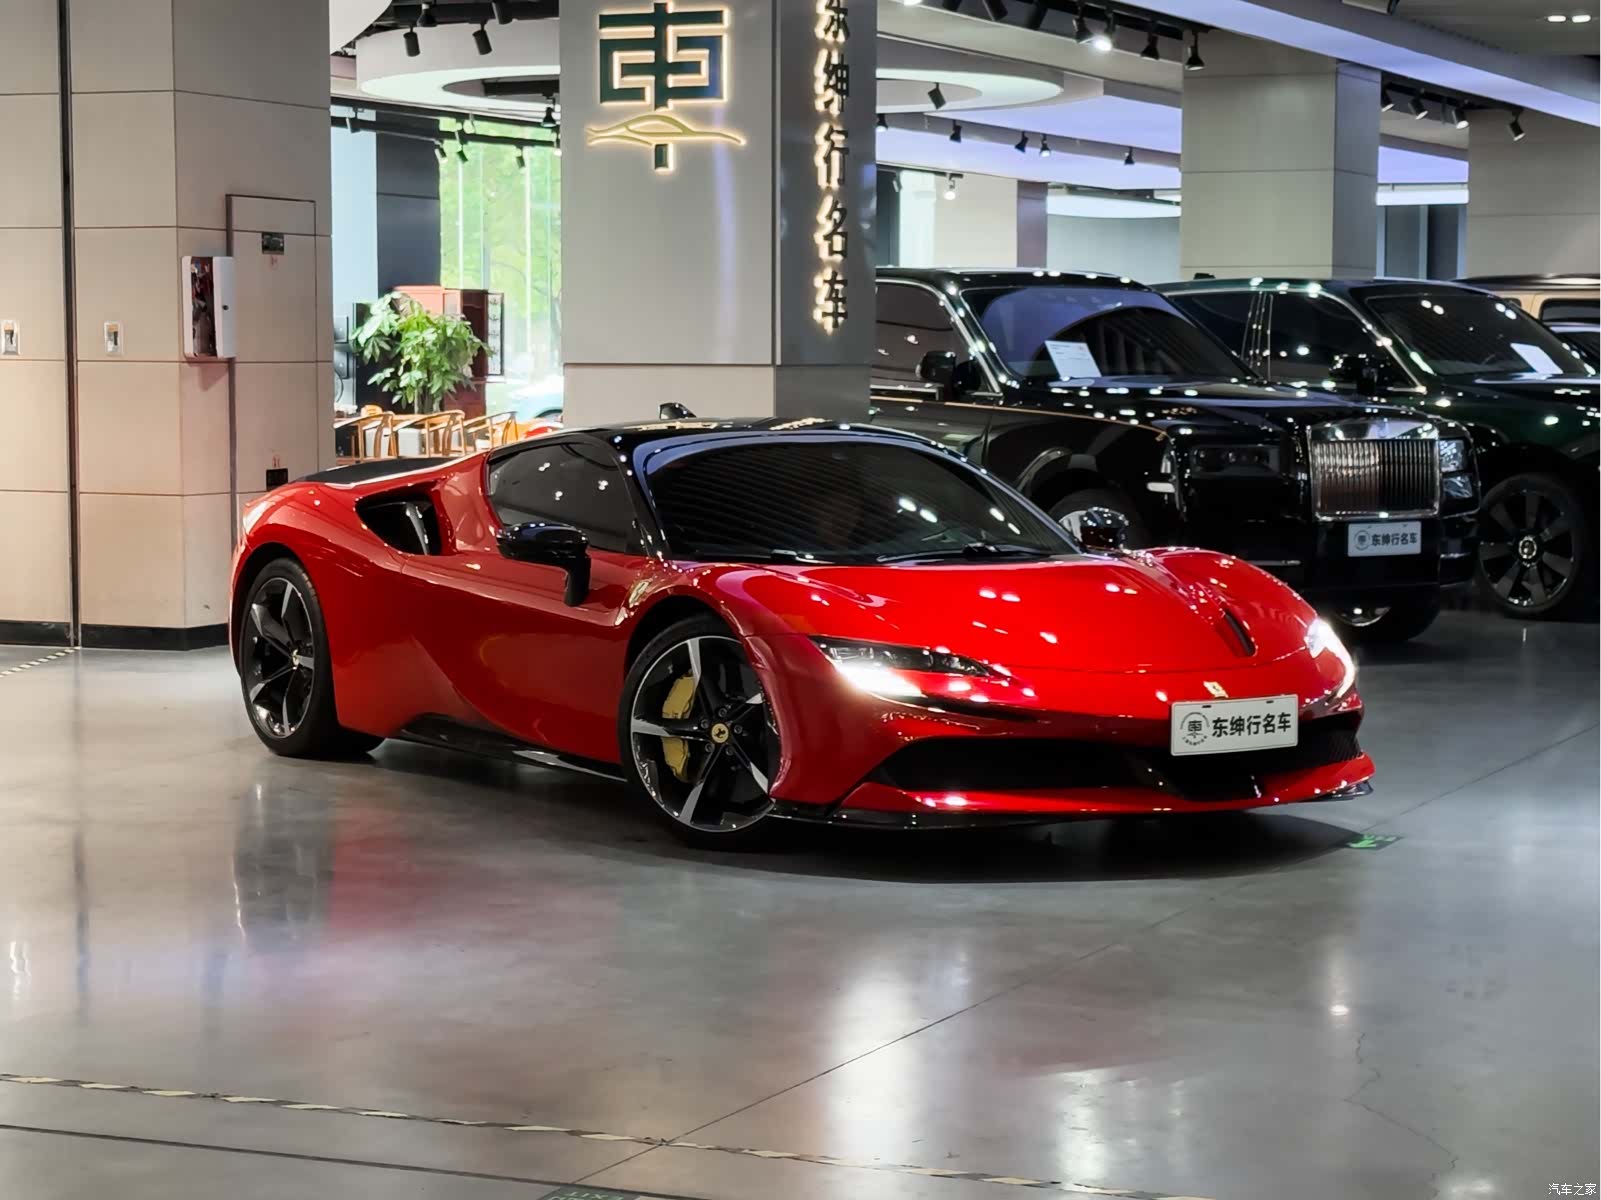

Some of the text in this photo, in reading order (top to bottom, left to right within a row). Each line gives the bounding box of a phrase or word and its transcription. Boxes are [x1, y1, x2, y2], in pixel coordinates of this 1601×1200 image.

[816, 0, 849, 331] 东绅行名车
[1212, 712, 1291, 738] 东绅行名车
